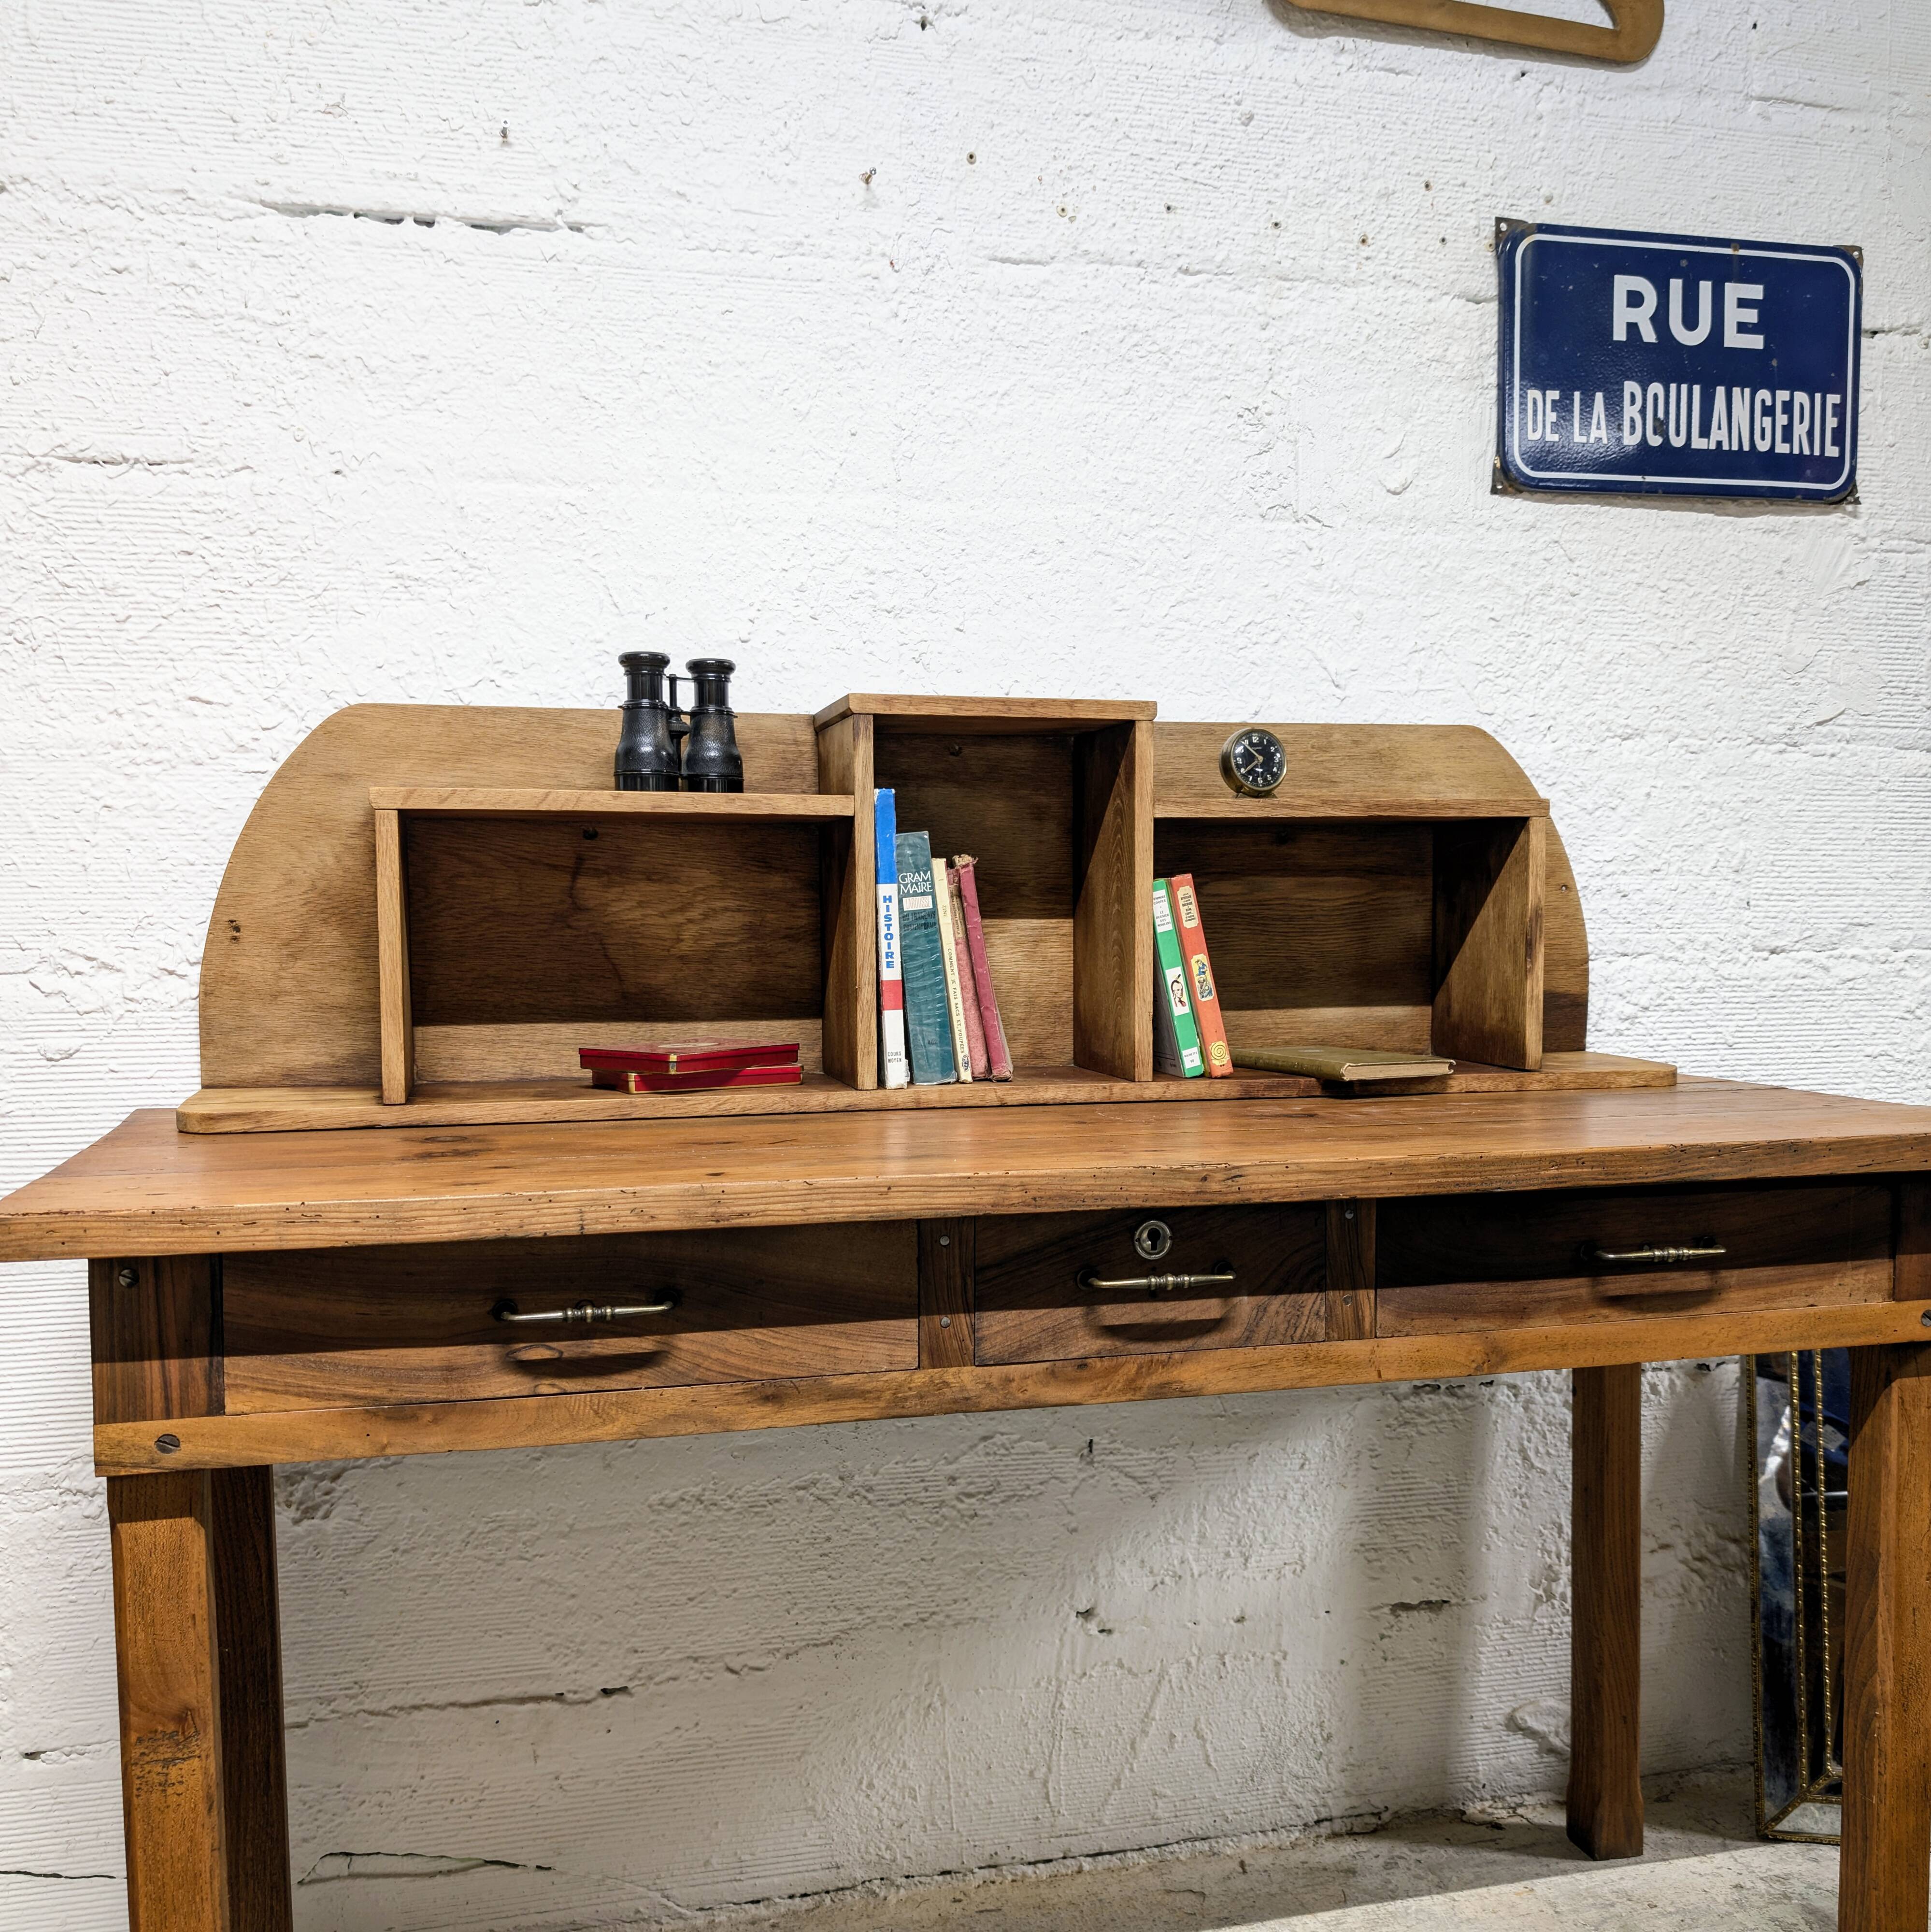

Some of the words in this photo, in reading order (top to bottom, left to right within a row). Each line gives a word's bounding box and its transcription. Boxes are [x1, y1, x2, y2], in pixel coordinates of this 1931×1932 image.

[1613, 274, 1764, 350] RUE
[1527, 389, 1560, 443] DE
[1573, 391, 1608, 445] LA
[1623, 381, 1841, 457] BOULANGERIE
[899, 871, 931, 883] GRAM
[905, 896, 931, 909] LAROUSSE
[883, 895, 894, 968] HISTOIRE
